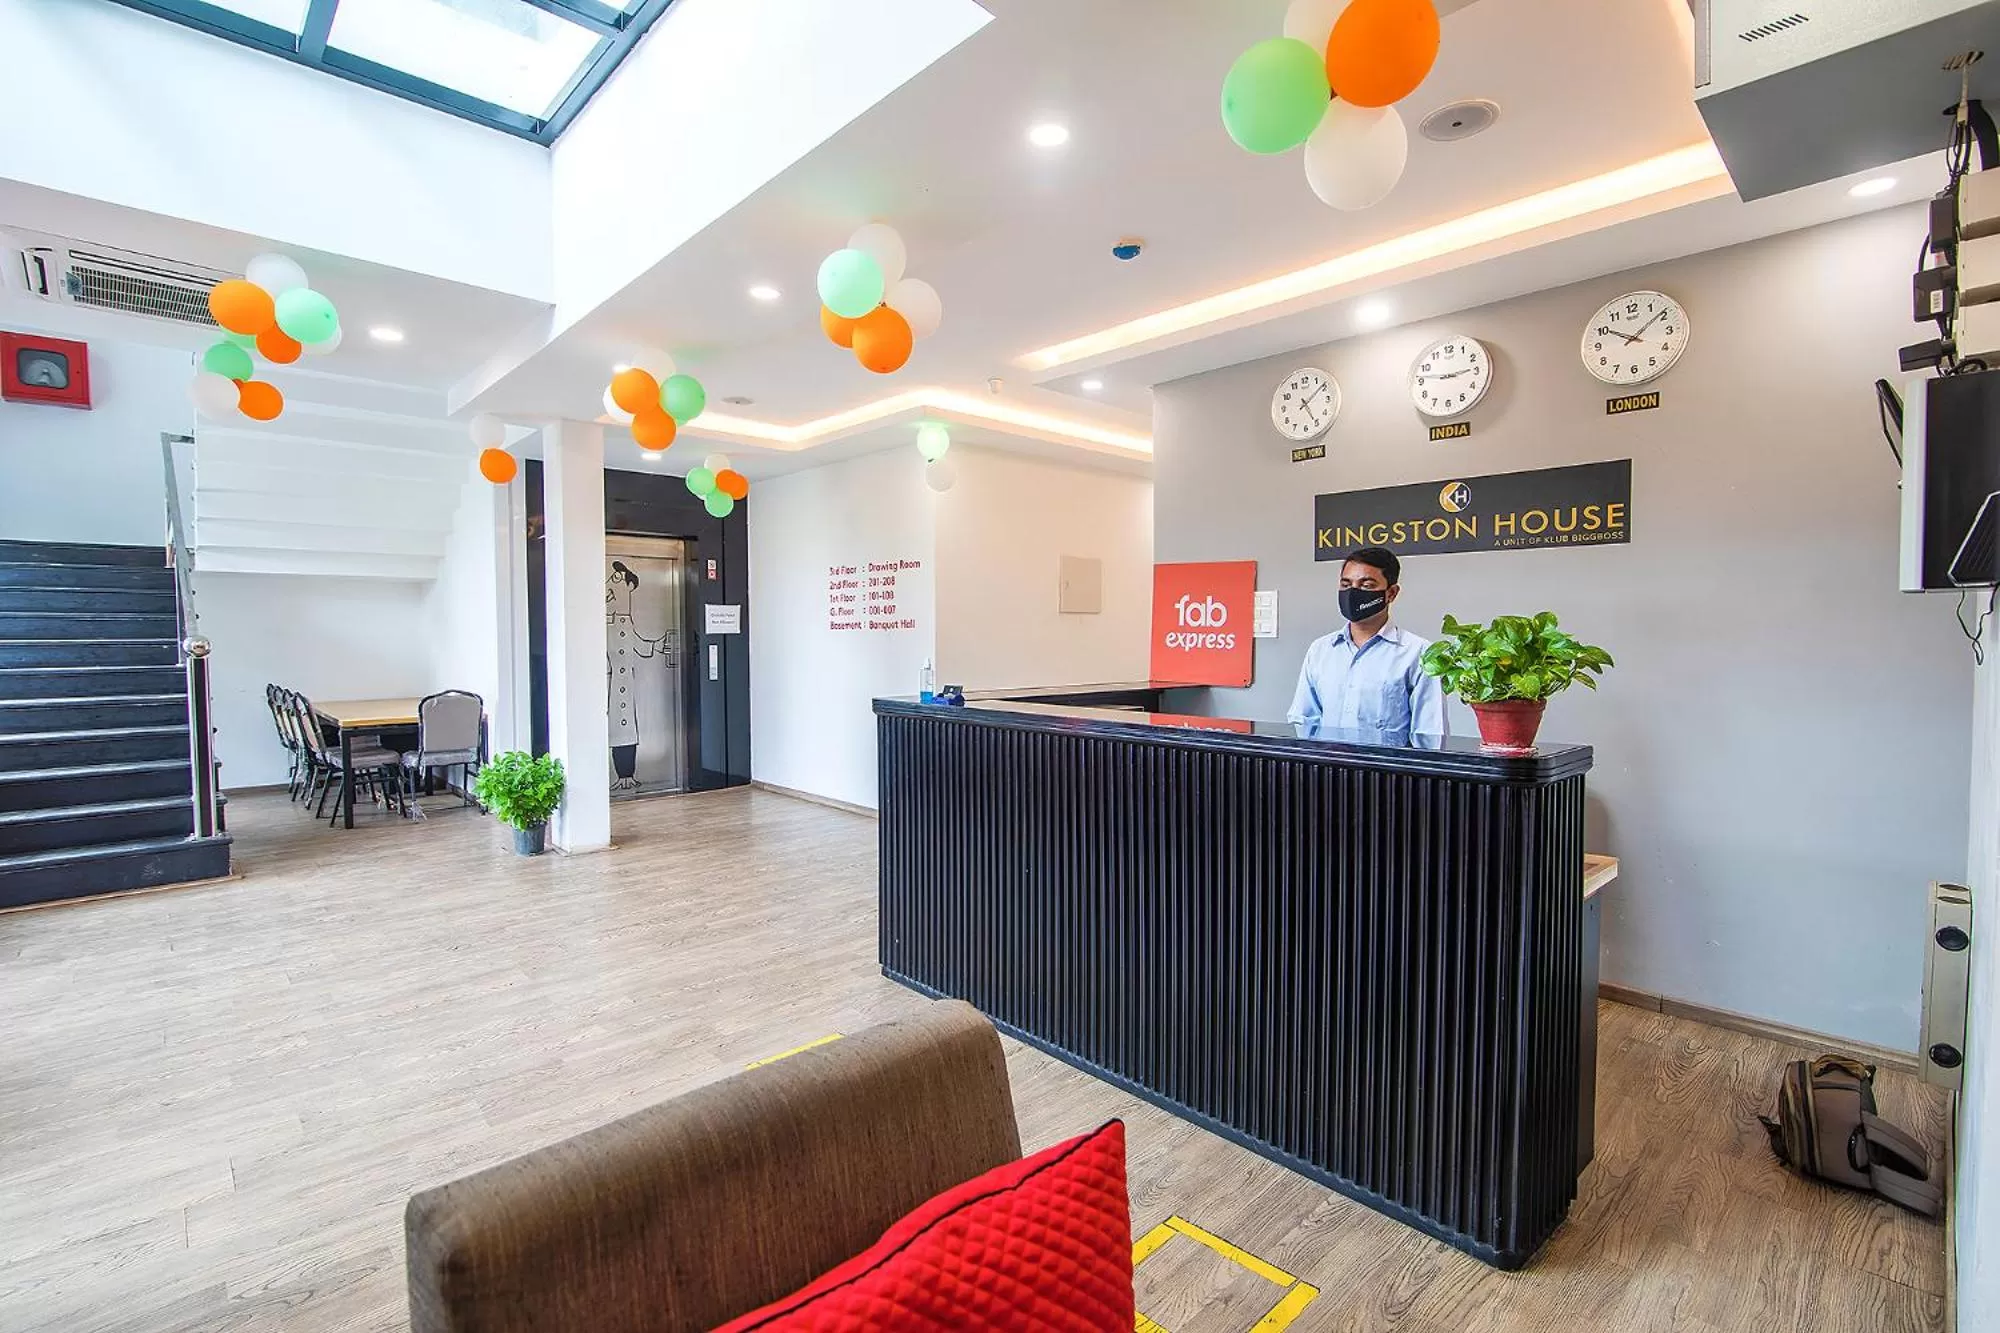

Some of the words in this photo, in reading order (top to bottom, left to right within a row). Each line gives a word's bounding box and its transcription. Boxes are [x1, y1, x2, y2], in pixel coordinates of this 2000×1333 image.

[1626, 303, 1638, 314] 12
[1648, 303, 1653, 312] 1
[1610, 312, 1620, 322] 11
[1660, 311, 1668, 321] 2
[1598, 326, 1609, 336] 10
[1665, 326, 1674, 335] 3
[1444, 345, 1454, 353] 12
[1461, 346, 1465, 354] 1
[1594, 342, 1602, 352] 9
[1661, 342, 1669, 351] 4
[1432, 352, 1440, 360] 11
[1470, 354, 1476, 362] 2
[1600, 357, 1607, 366] 8
[1649, 357, 1656, 366] 5
[1421, 364, 1431, 372] 10
[1474, 366, 1480, 376] 3
[1613, 364, 1620, 374] 7
[1631, 365, 1638, 374] 6
[1301, 376, 1309, 384] 12
[1418, 378, 1424, 386] 9
[1291, 382, 1298, 390] 11
[1322, 384, 1328, 392] 2
[1470, 381, 1476, 390] 4
[1422, 390, 1428, 399] 8
[1460, 393, 1466, 402] 5
[1432, 398, 1438, 407] 7
[1445, 400, 1452, 408] 6
[1609, 394, 1657, 412] LONDON
[1322, 408, 1328, 416] 4
[1314, 419, 1320, 427] 5
[1431, 424, 1468, 440] INDIA
[1318, 515, 1477, 548] KINGSTON
[1494, 503, 1625, 536] HOUSE
[1504, 538, 1525, 546] UNIT
[1529, 537, 1541, 545] OF
[1544, 535, 1569, 543] KLUB
[1572, 532, 1624, 542] BIGGBOSS
[841, 566, 857, 574] Floor
[868, 560, 898, 573] Drawing
[900, 560, 921, 569] Room
[830, 581, 841, 590] 2nd
[842, 580, 858, 588] Floor
[830, 594, 839, 603] 1st
[840, 593, 856, 602] Floor
[830, 607, 837, 616] G.
[838, 607, 855, 616] Floor
[1174, 594, 1228, 628] fab
[830, 621, 862, 630] Basement
[869, 620, 898, 631] Banquet
[900, 619, 915, 629] Hall
[1166, 631, 1236, 652] express
